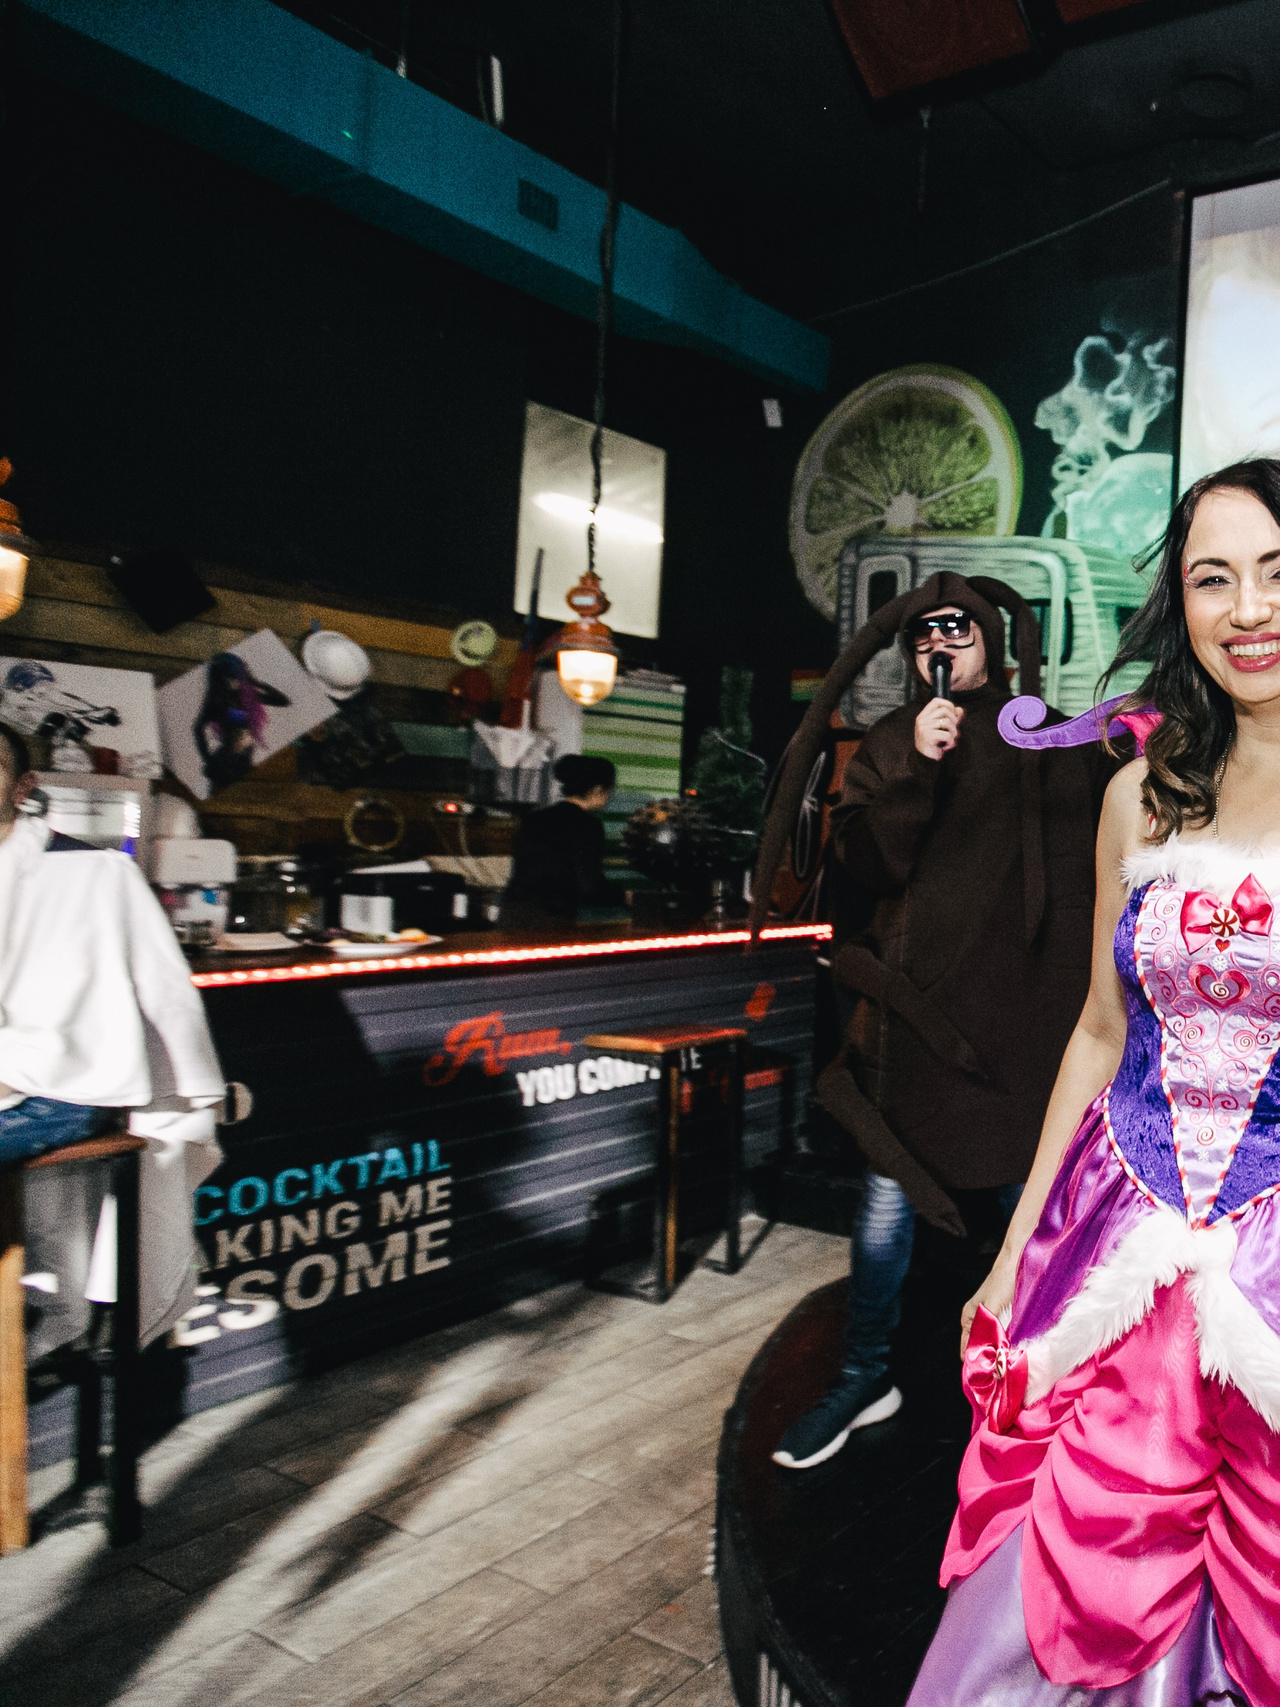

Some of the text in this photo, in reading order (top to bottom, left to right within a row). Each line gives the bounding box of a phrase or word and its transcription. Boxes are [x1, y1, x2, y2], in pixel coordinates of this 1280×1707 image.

[515, 1063, 576, 1107] YOU
[193, 1139, 452, 1226] COCKTAIL
[378, 1176, 452, 1228] ME
